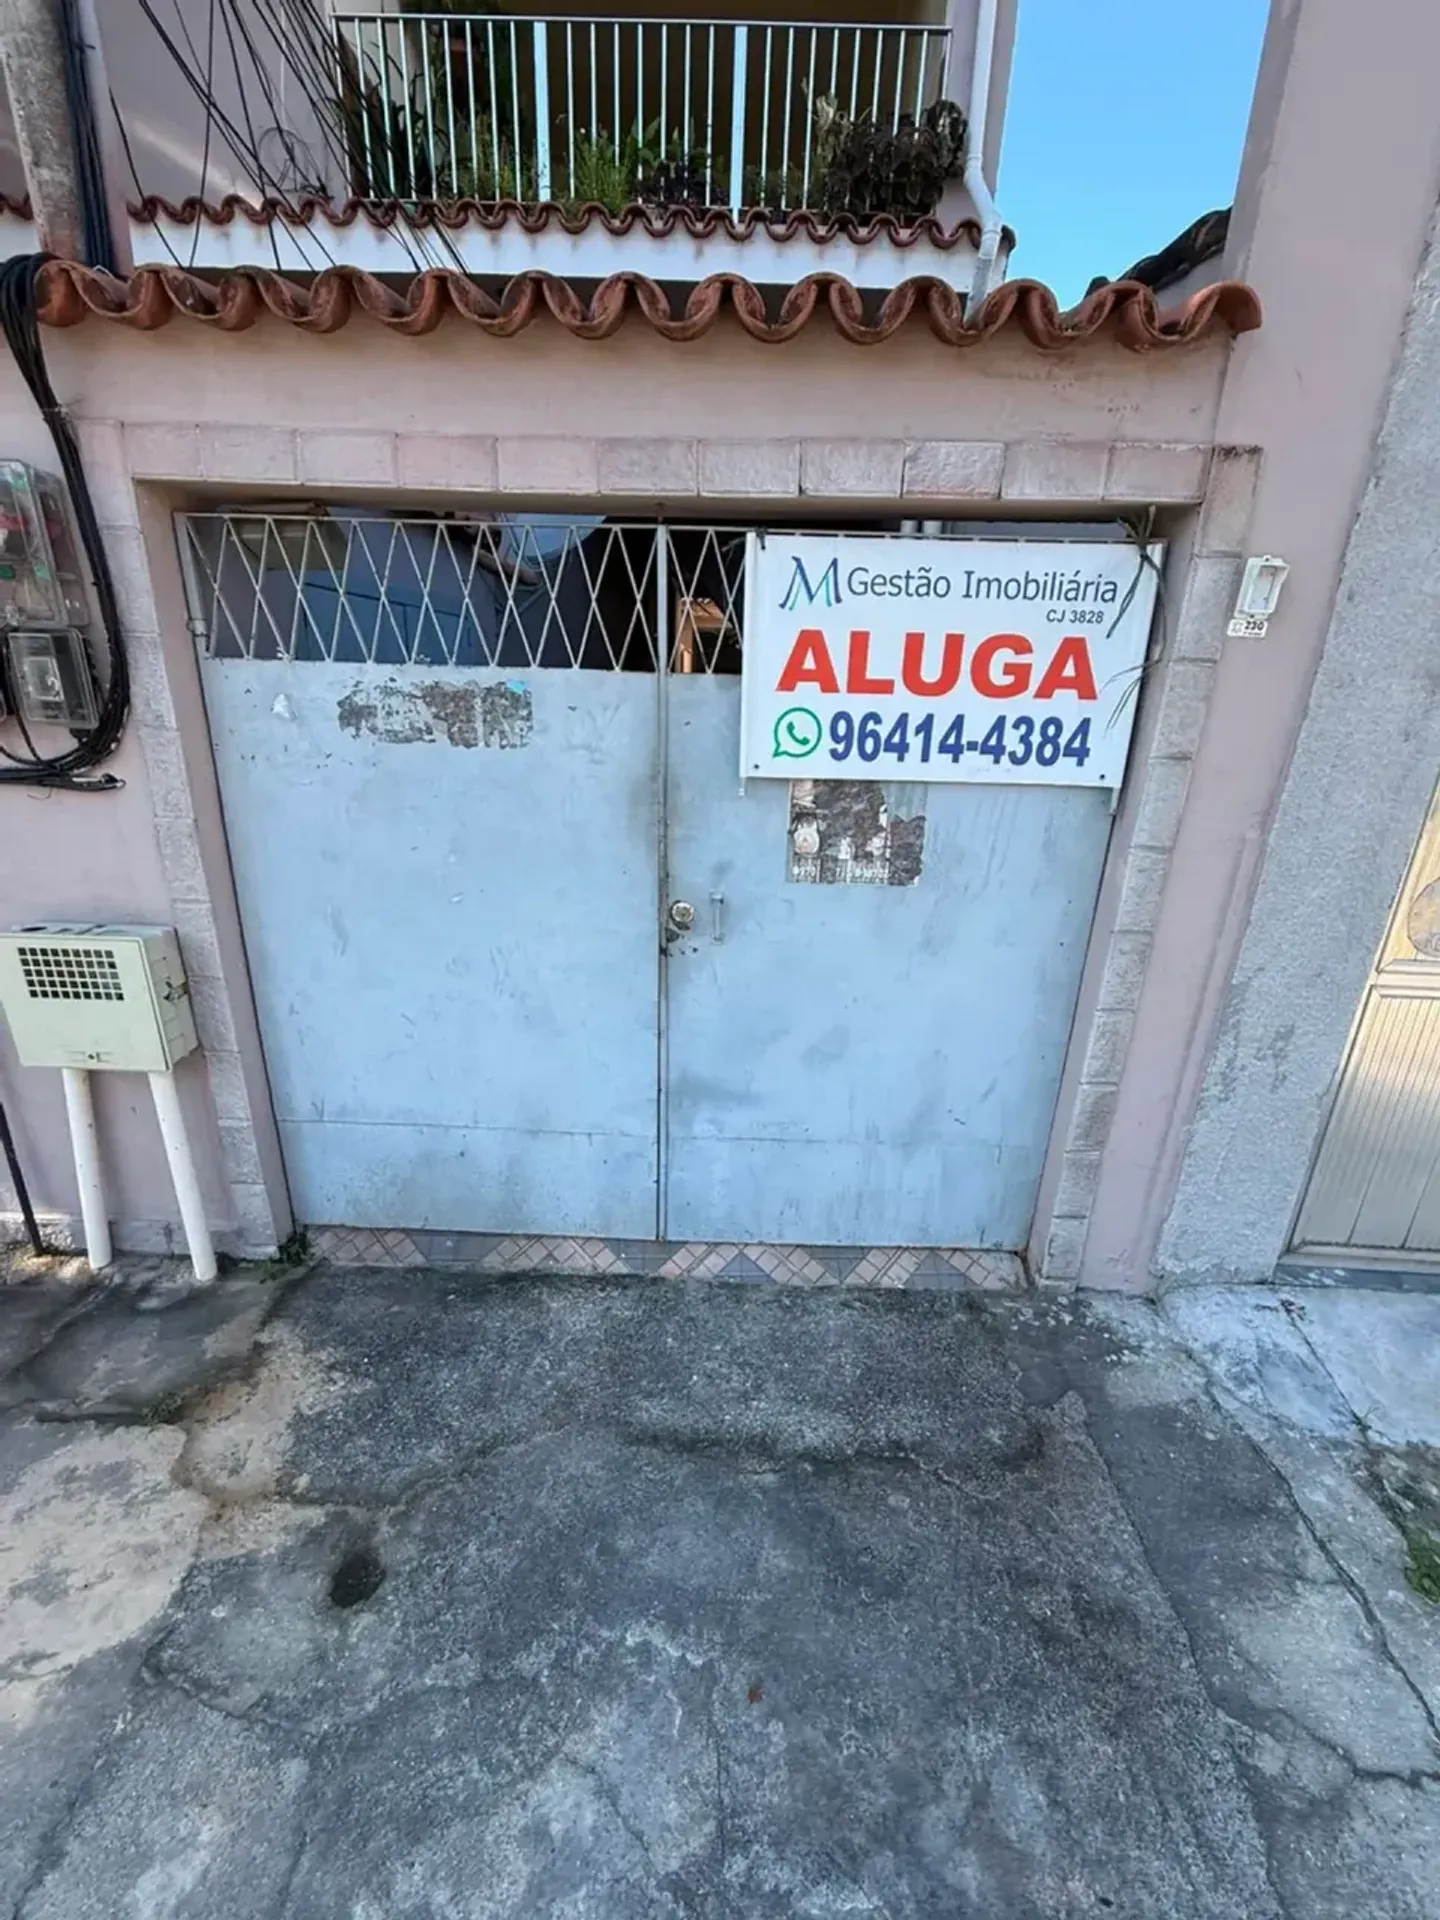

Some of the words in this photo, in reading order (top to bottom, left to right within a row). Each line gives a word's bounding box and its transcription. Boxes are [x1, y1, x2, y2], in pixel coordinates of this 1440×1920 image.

[847, 566, 951, 599] Gestão
[962, 569, 1118, 604] Imobiliária
[1046, 609, 1066, 623] CJ
[1069, 610, 1104, 625] 3828
[775, 629, 1098, 701] ALUGA
[829, 710, 1092, 767] 96414-4384
